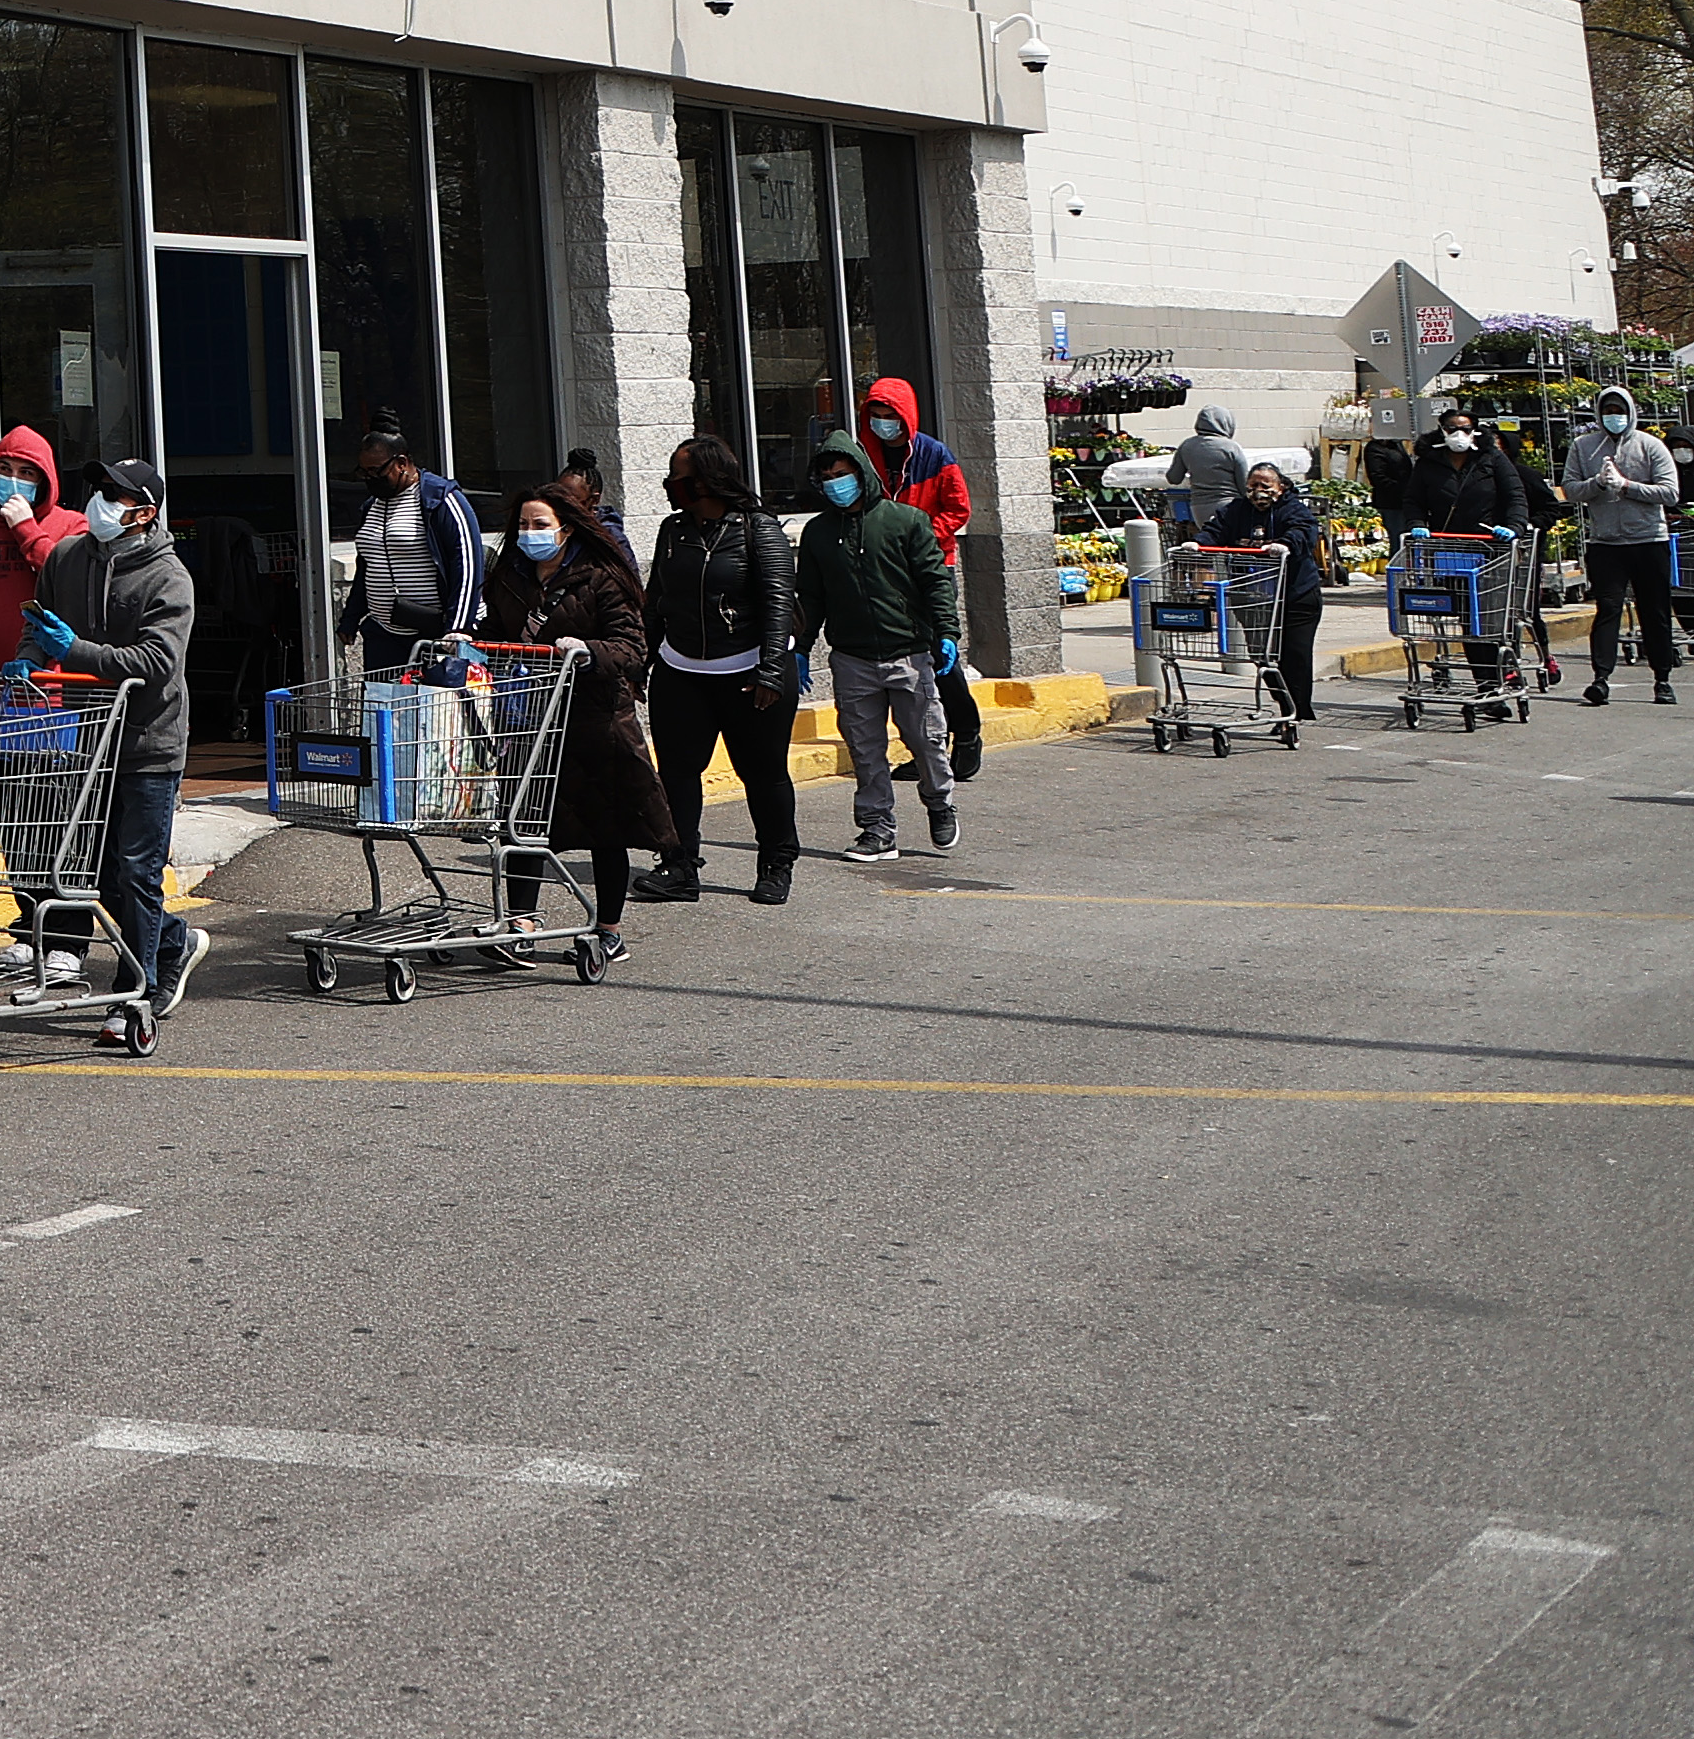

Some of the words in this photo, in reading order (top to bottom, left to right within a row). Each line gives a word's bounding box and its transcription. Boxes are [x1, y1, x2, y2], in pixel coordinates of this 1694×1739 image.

[758, 179, 794, 220] EXIT
[1421, 320, 1449, 328] (516)
[1423, 328, 1448, 336] 232
[1420, 335, 1453, 344] 0007
[306, 751, 340, 763] Walmart
